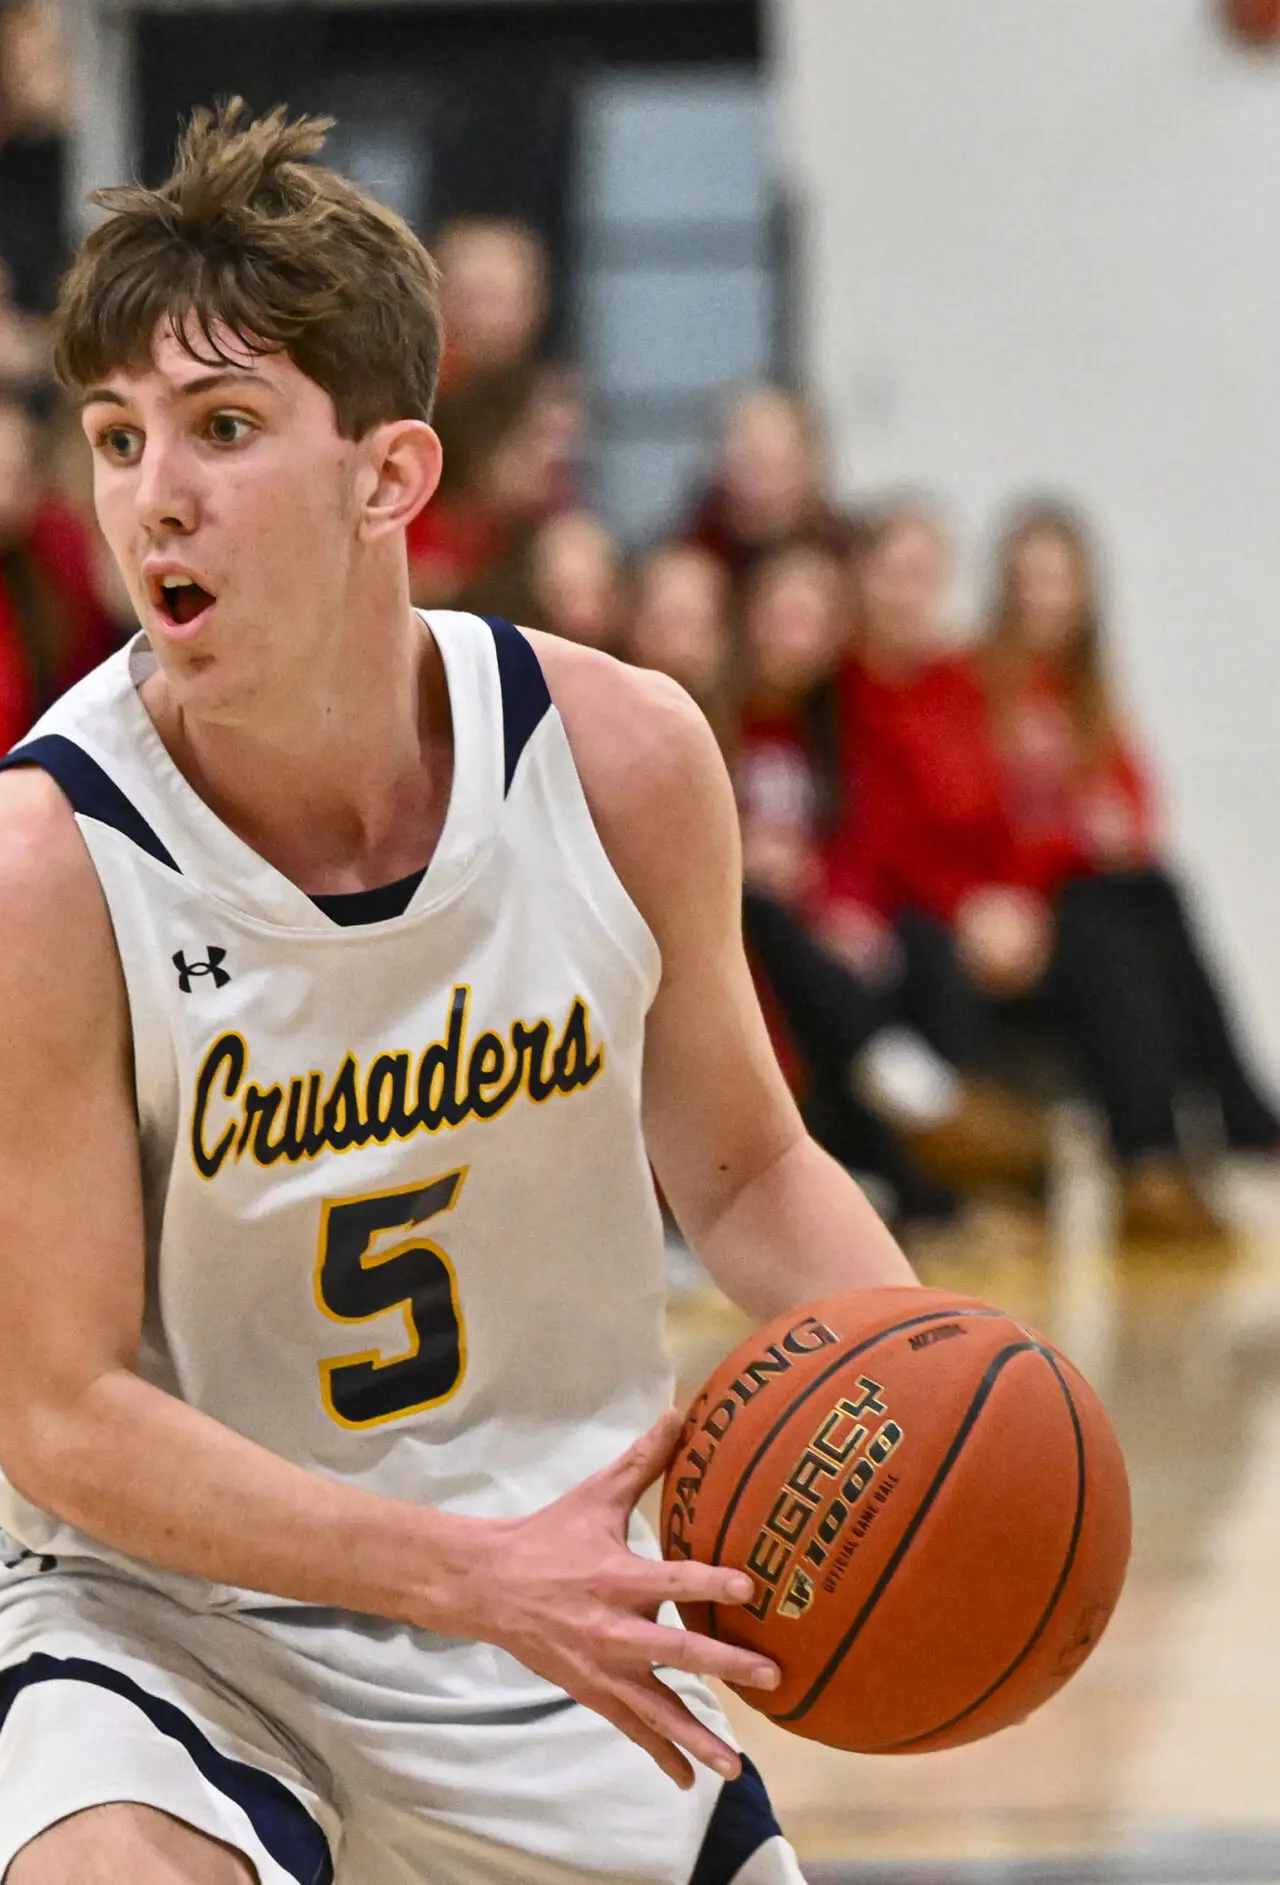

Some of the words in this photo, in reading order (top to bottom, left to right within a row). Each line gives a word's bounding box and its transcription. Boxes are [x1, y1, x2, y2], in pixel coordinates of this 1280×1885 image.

[191, 983, 604, 1181] Crusaders
[314, 1165, 470, 1430] 5
[671, 1316, 841, 1560] PALDING
[741, 1375, 888, 1623] LEGACY
[802, 1419, 904, 1571] 1000
[823, 1541, 859, 1594] OFFICIAL
[852, 1505, 879, 1538] GAME
[874, 1473, 898, 1503] BALL
